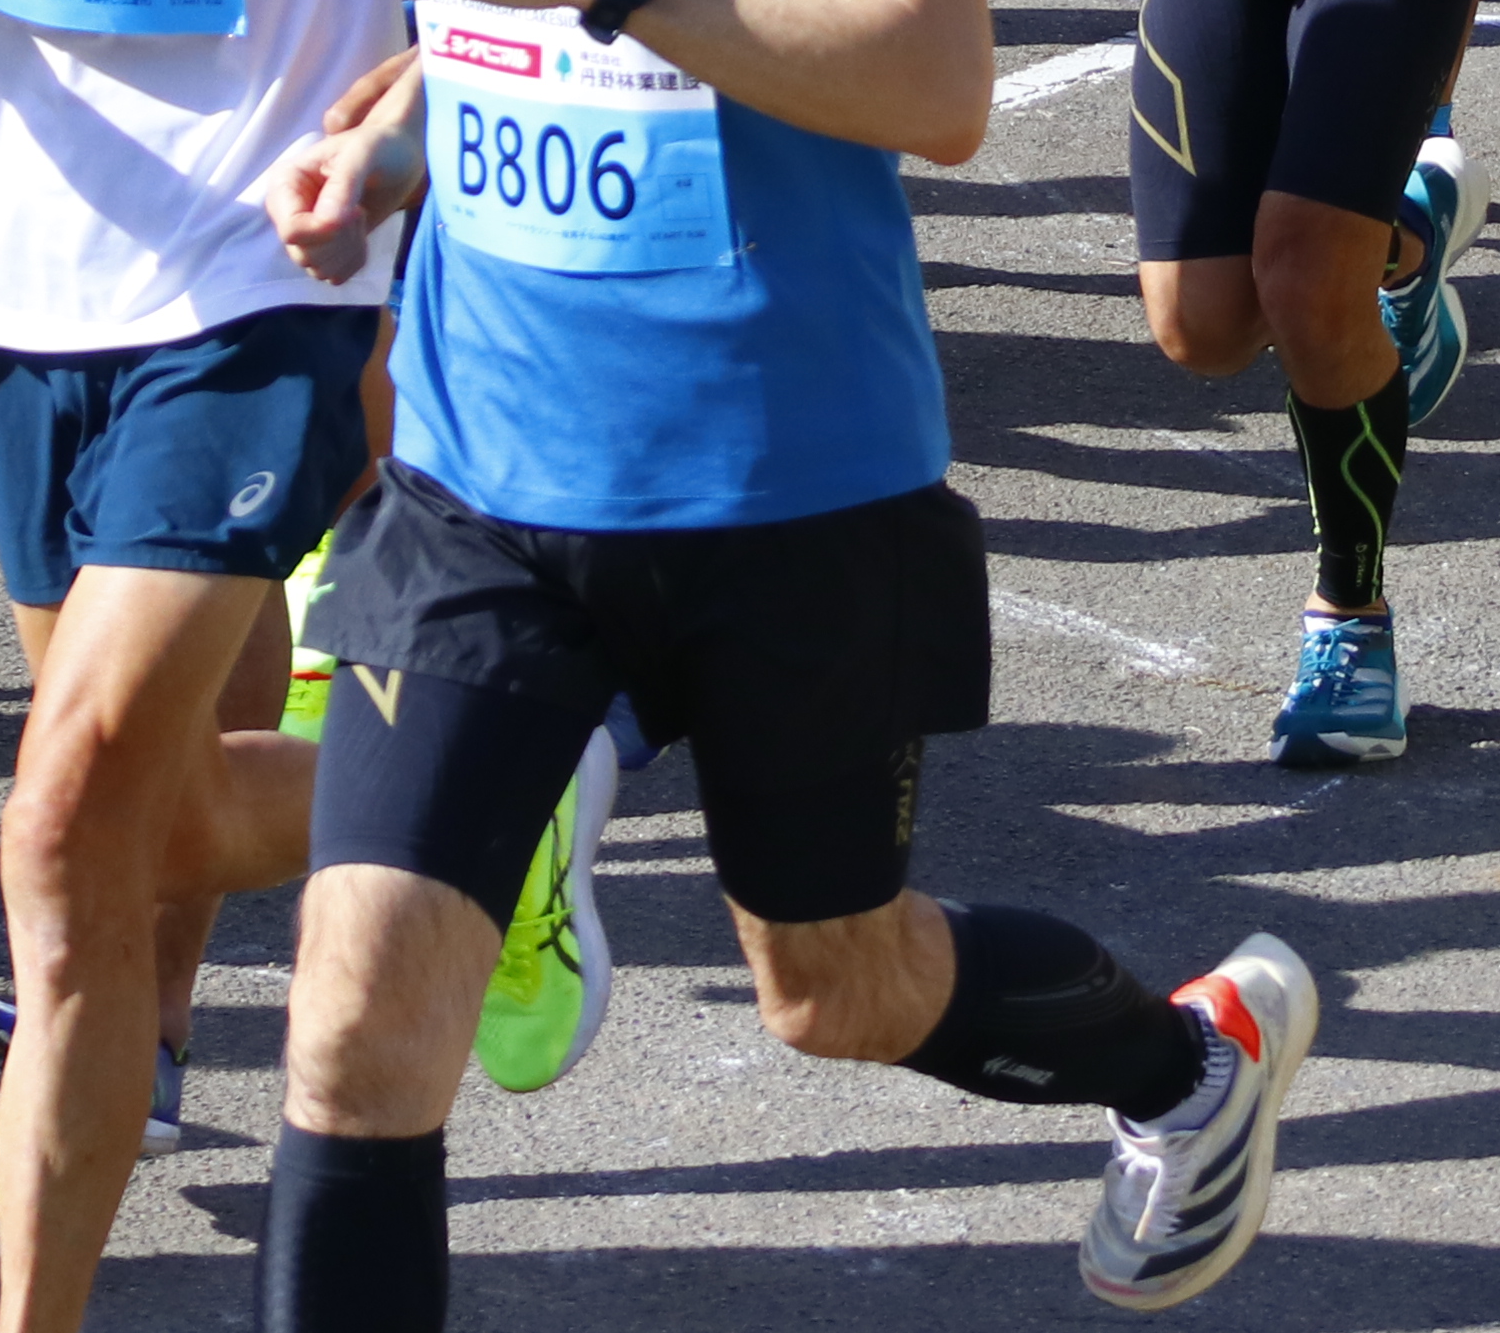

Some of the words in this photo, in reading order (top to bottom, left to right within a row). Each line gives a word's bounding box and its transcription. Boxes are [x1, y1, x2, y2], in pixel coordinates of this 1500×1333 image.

[524, 4, 580, 29] LAKESID
[451, 35, 531, 70] ヨークベニマル
[458, 101, 635, 221] B806
